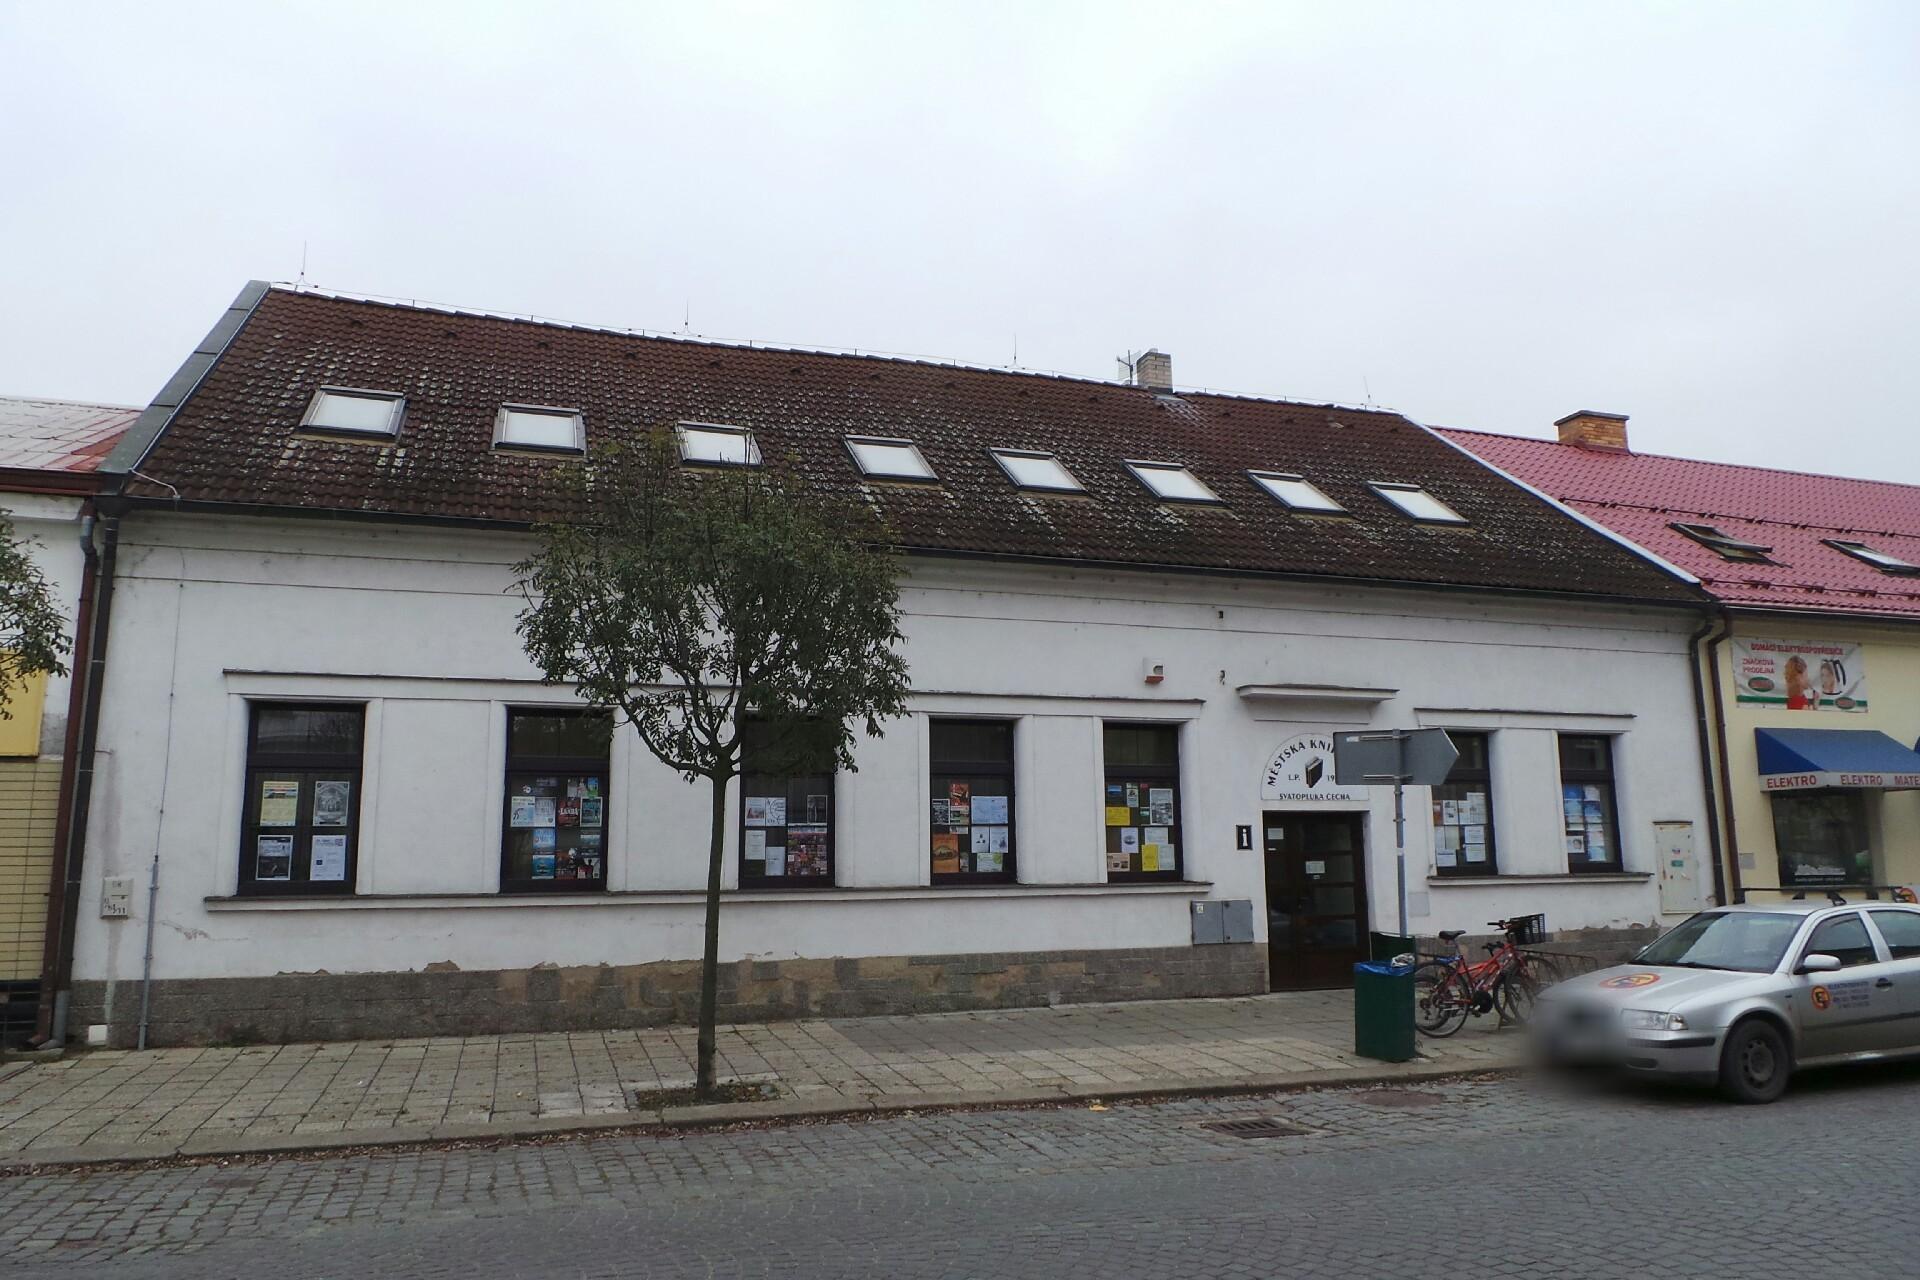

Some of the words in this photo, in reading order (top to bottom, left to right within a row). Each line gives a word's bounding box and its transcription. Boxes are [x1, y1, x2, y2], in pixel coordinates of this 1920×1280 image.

[1767, 775, 1817, 789] ELEKTRO
[1840, 775, 1883, 786] ELEKTRO
[1279, 793, 1324, 801] SVATOPLUKA
